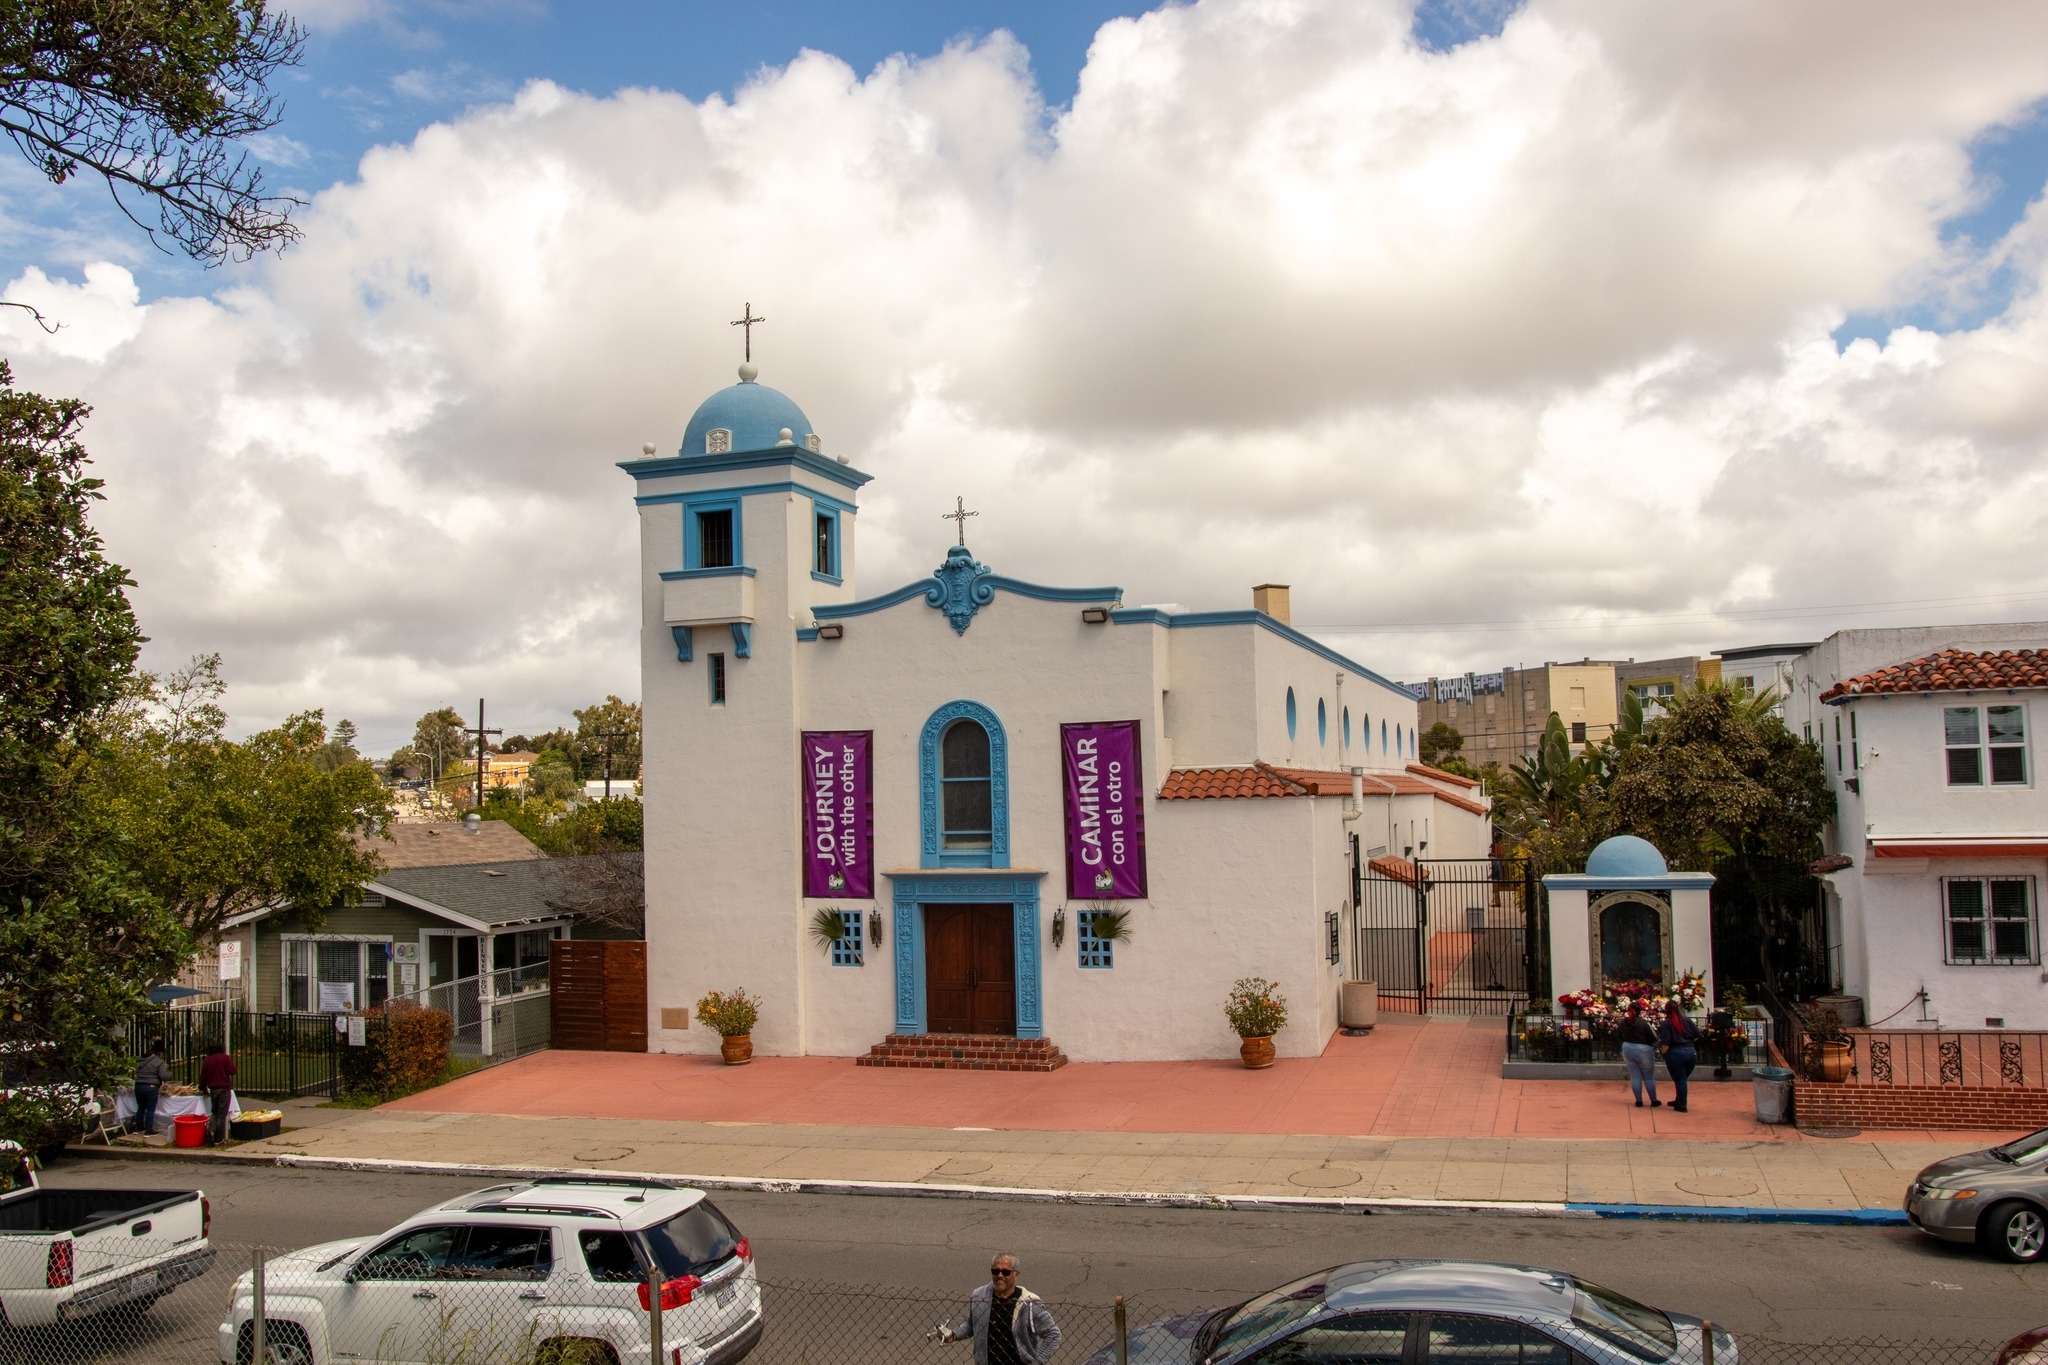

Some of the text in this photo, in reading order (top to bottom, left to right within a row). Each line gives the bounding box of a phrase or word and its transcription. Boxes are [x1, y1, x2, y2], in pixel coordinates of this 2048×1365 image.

[815, 745, 836, 866] JOURNEY
[838, 744, 856, 866] with the other
[1077, 737, 1103, 866] CAMINAR
[1106, 760, 1125, 865] con el otro
